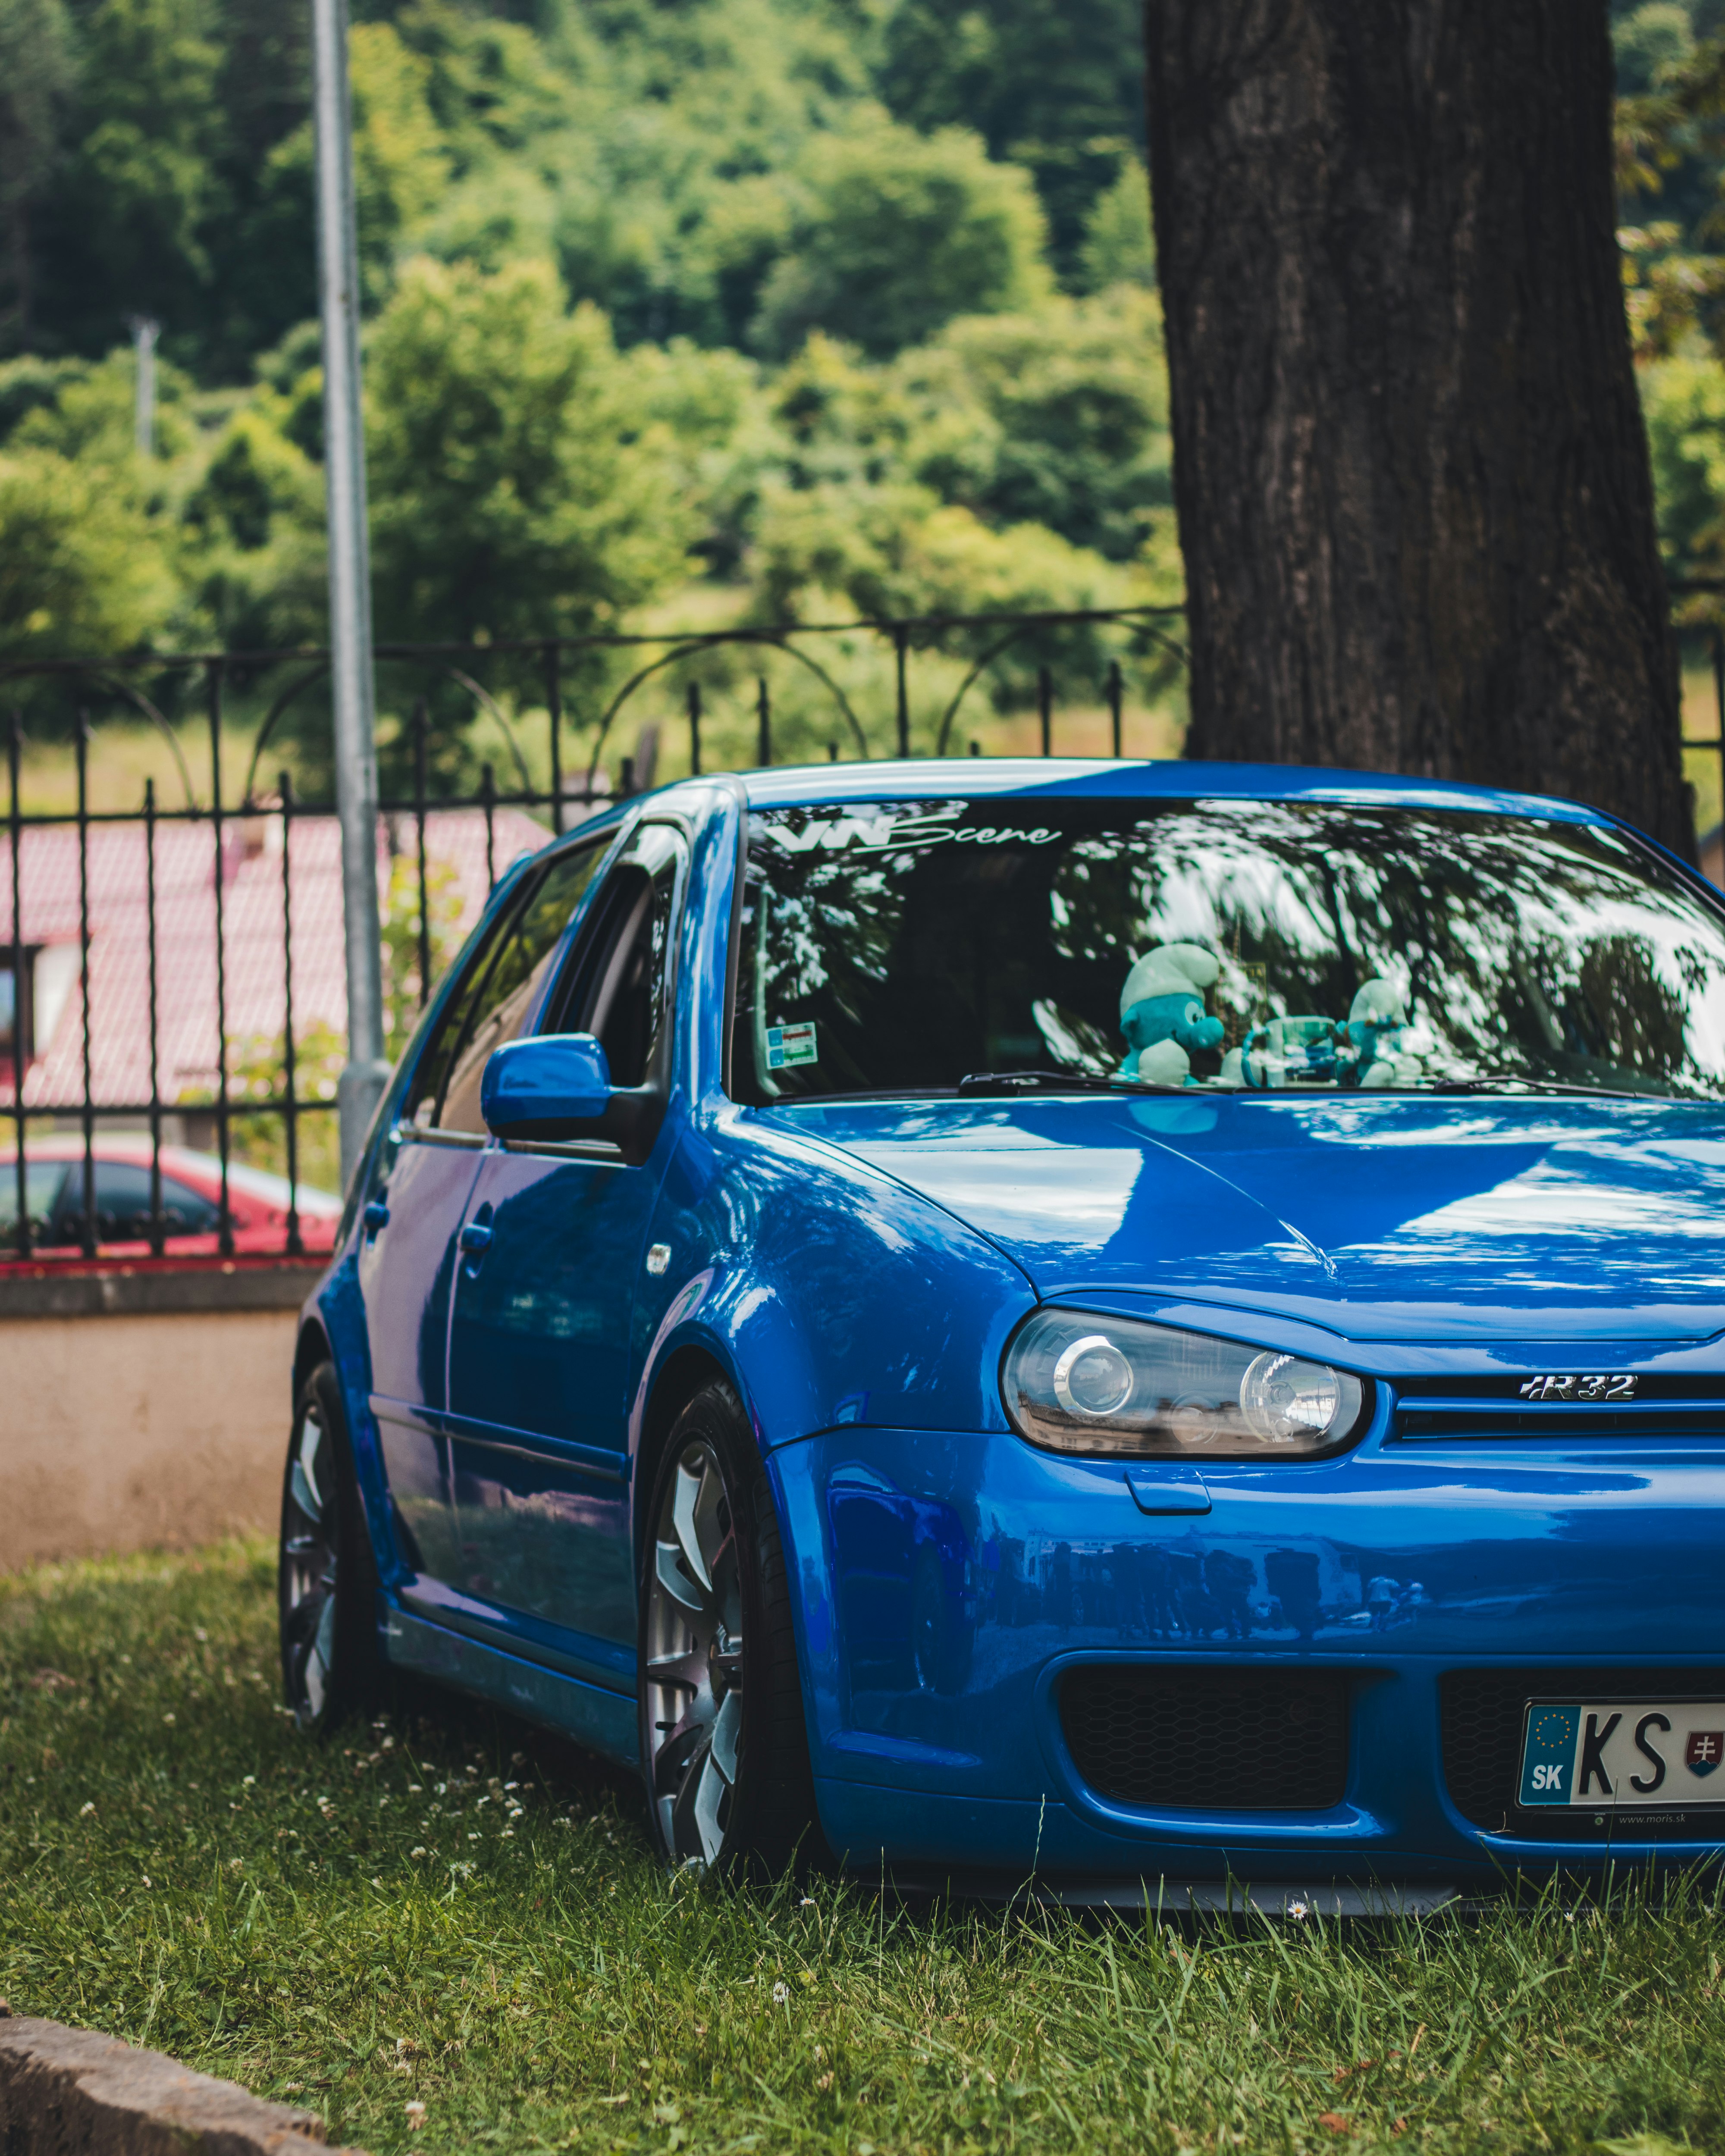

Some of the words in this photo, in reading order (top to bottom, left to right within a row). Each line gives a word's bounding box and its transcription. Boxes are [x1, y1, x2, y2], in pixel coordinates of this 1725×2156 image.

[852, 813, 1062, 853] Scene
[1540, 1376, 1638, 1400] R32
[1579, 1712, 1672, 1794] KS
[1531, 1764, 1564, 1789] SK
[1619, 1814, 1686, 1824] www.moris.sk
